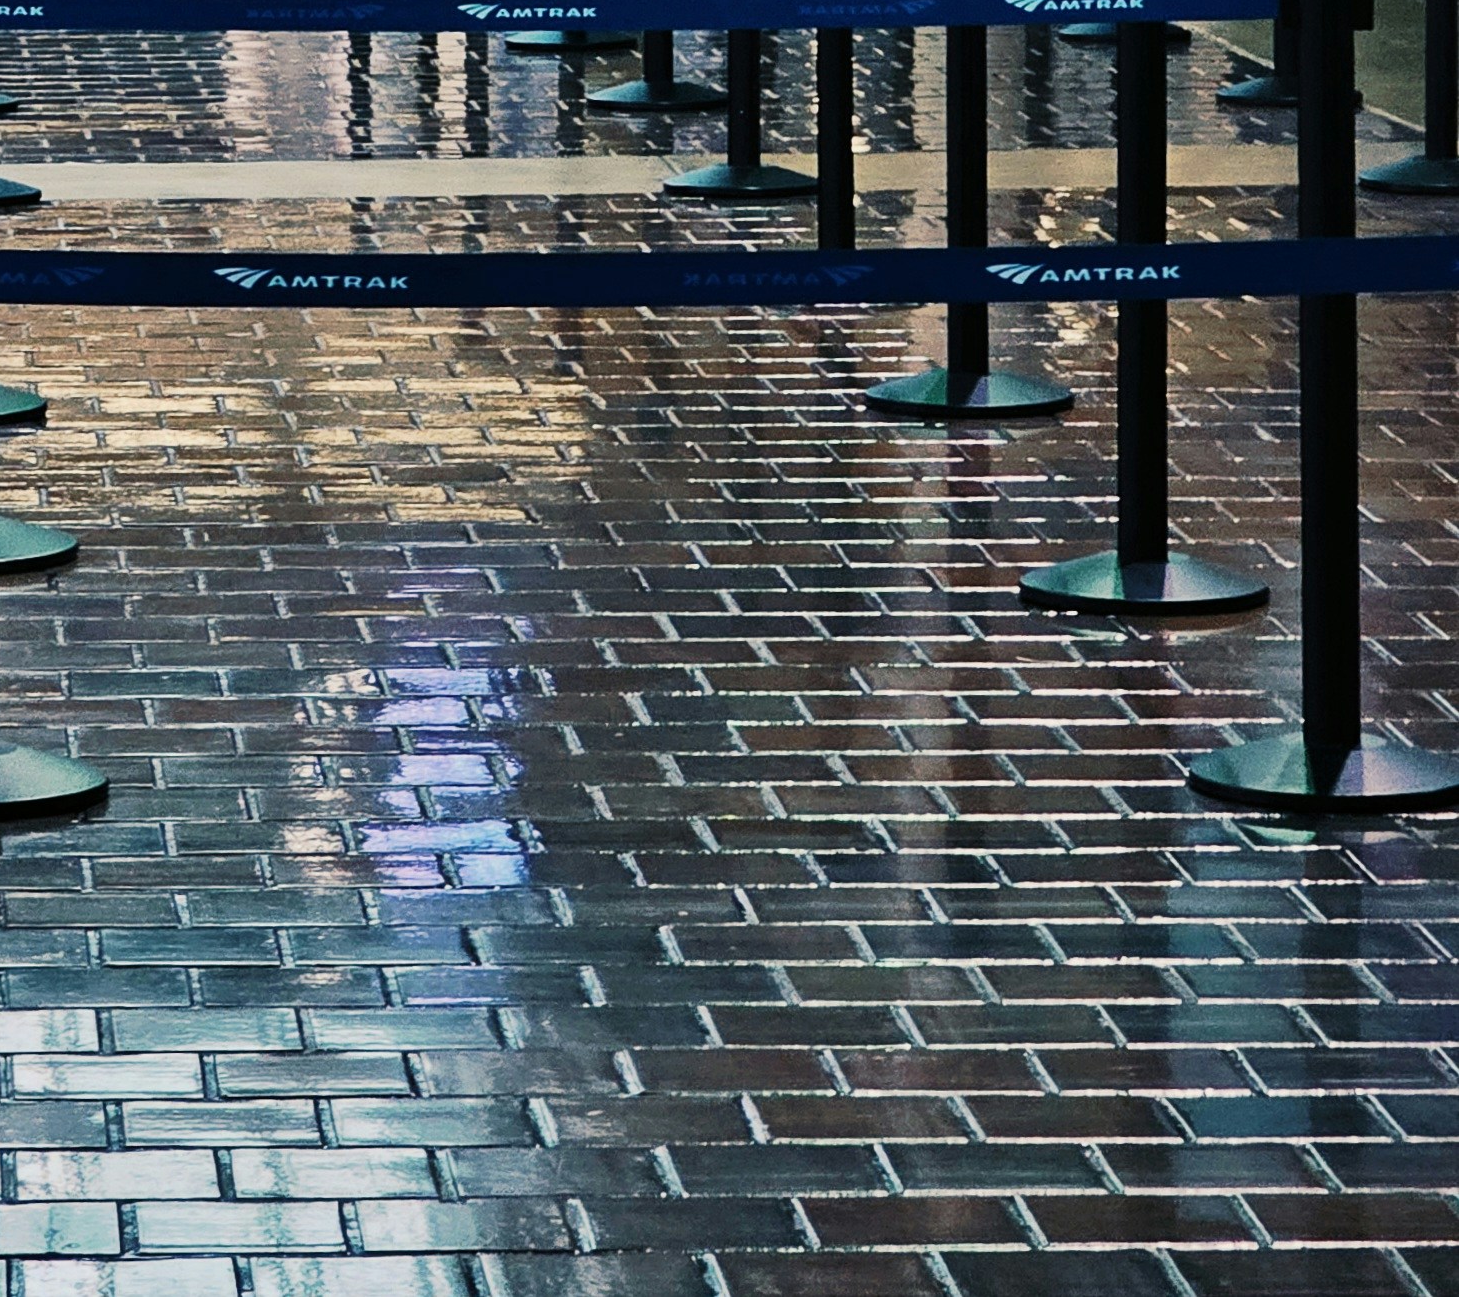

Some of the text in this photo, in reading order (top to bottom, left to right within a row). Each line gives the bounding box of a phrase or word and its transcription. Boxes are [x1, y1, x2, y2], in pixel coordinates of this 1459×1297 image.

[495, 6, 597, 18] AMTRAK
[267, 273, 409, 289] AMTRAK
[1039, 264, 1182, 282] AMTRAK
